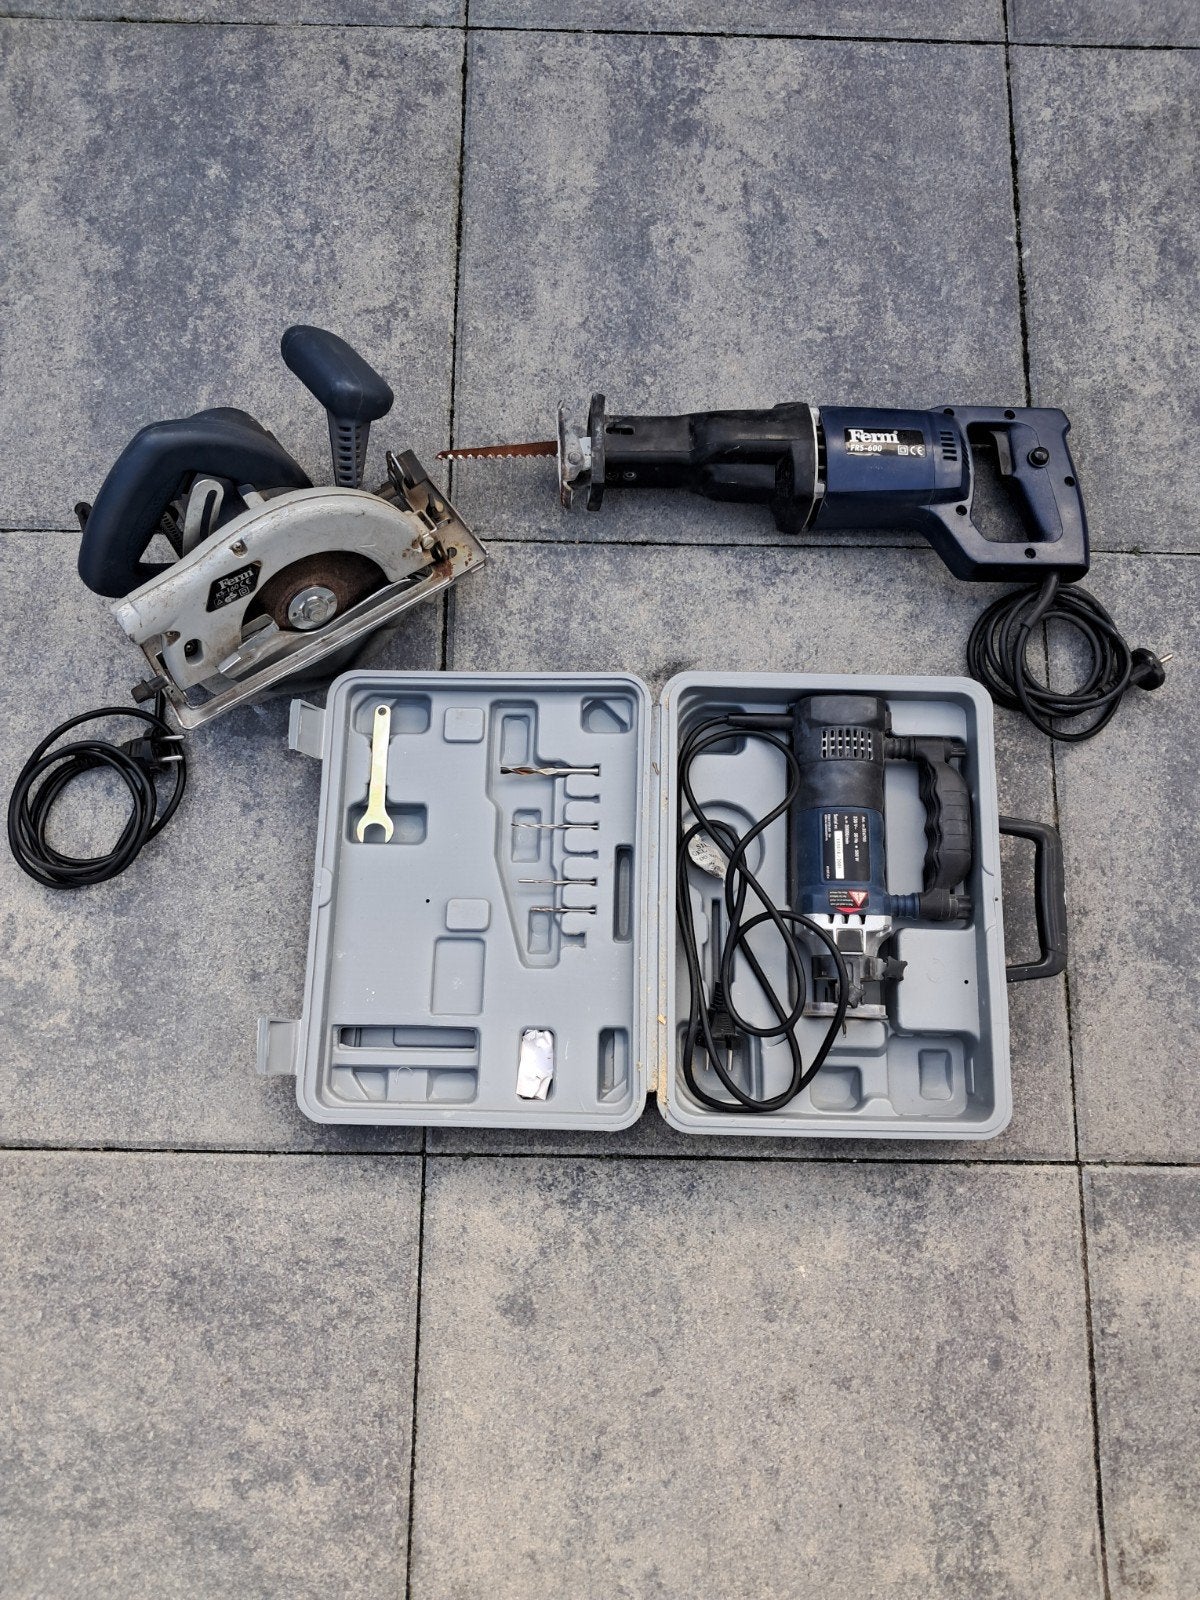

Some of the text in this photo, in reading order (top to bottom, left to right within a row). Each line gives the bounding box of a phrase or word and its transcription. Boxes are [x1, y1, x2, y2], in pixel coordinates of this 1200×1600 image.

[848, 429, 900, 444] Ferm
[850, 444, 883, 452] FRS-600
[218, 570, 254, 590] Ferm
